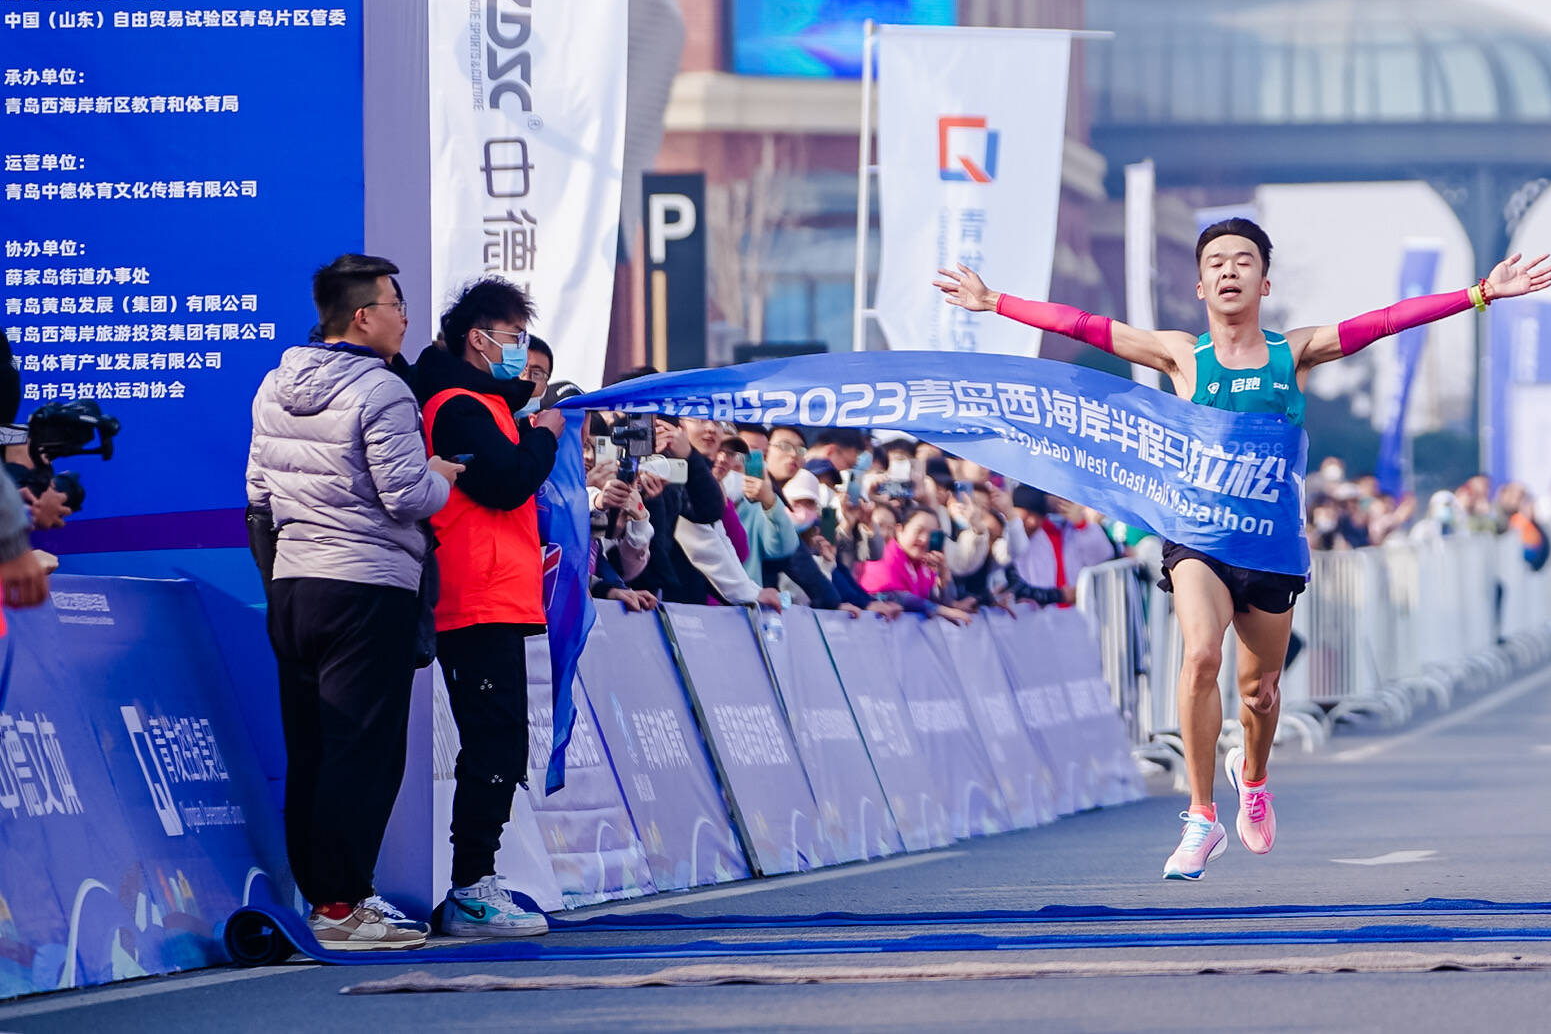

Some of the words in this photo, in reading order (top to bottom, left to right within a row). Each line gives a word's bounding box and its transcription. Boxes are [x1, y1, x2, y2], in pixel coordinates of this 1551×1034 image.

[4, 9, 347, 29] 中国（山东）自由贸易试验区青岛片区管委
[4, 68, 84, 86] 承办单位：
[4, 95, 239, 115] 青岛西海岸新区教育和体育局
[4, 154, 85, 172] 运营单位：
[5, 181, 257, 201] 青岛中德体育文化传播有限公司
[480, 136, 537, 298] 中德
[648, 194, 697, 264] P
[5, 240, 85, 258] 协办单位：
[5, 267, 150, 286] 薛家岛街道办事处
[5, 295, 258, 315] 青岛黄岛发展（集团）有限公司
[5, 323, 276, 344] 青岛西海岸旅游投资集团有限公司
[24, 380, 186, 401] 岛市马拉松运动协会
[1231, 376, 1261, 393] 启跑
[1074, 449, 1109, 478] West
[1111, 461, 1146, 494] Coast
